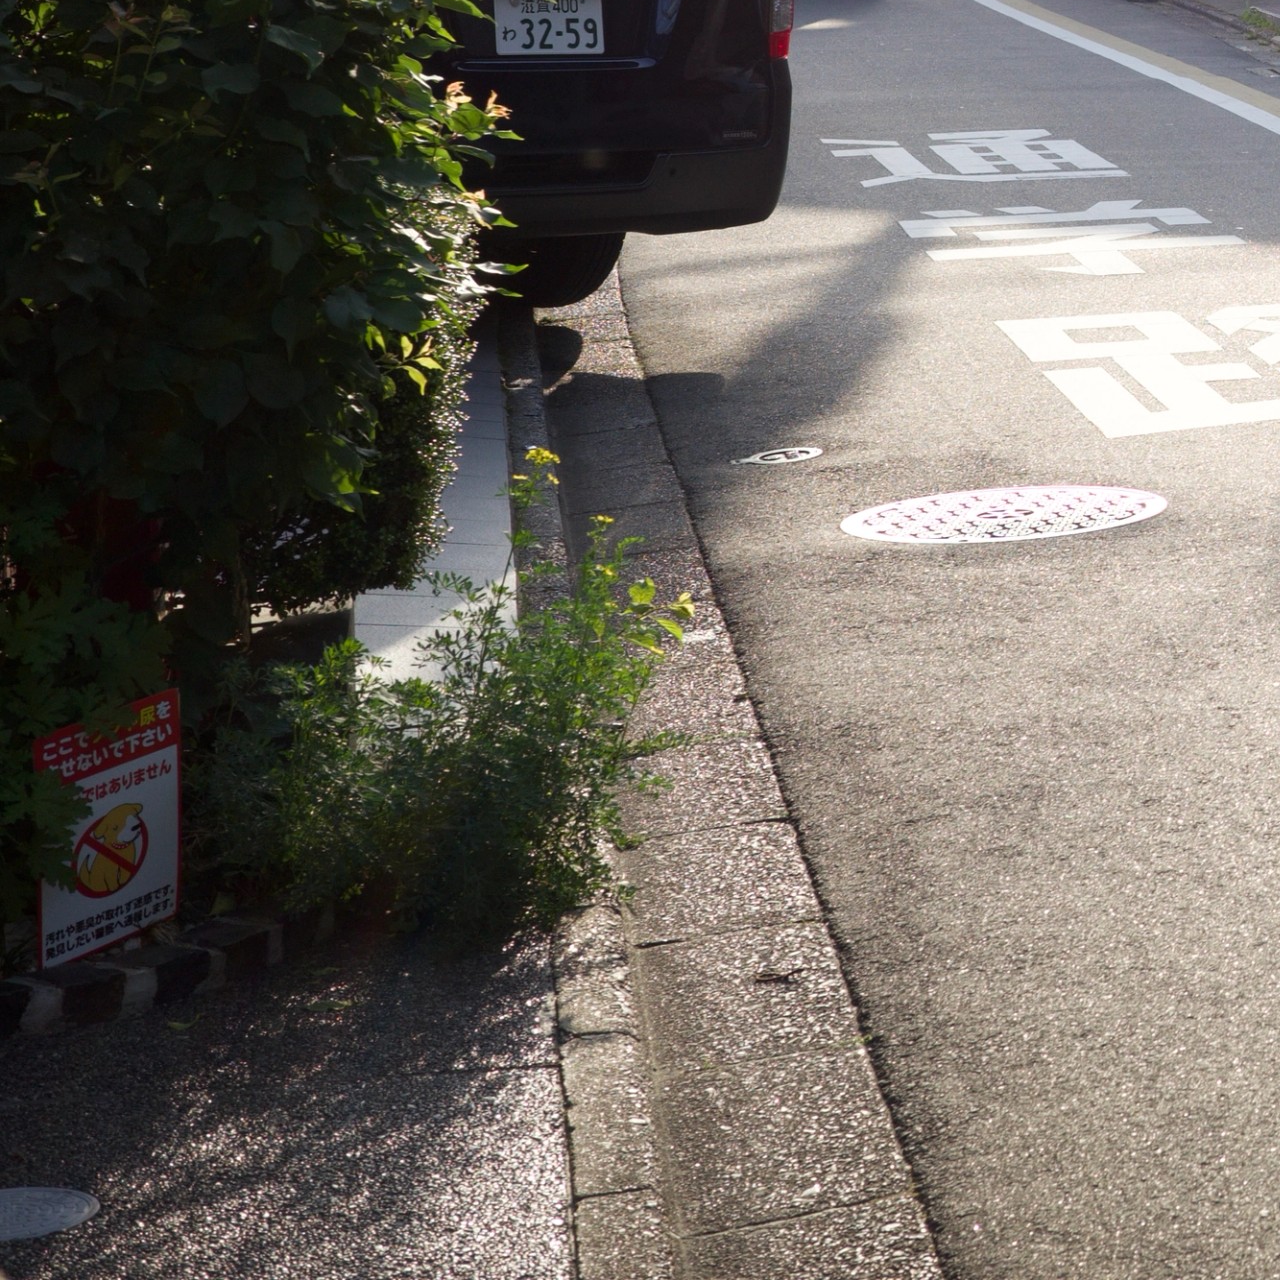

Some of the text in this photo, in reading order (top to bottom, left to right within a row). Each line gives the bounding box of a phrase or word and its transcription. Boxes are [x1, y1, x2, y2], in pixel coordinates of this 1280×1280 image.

[520, 18, 599, 50] 32-59
[42, 700, 171, 761] ここで尿を
[48, 723, 173, 777] せないで下さい
[82, 759, 172, 802] ではありません
